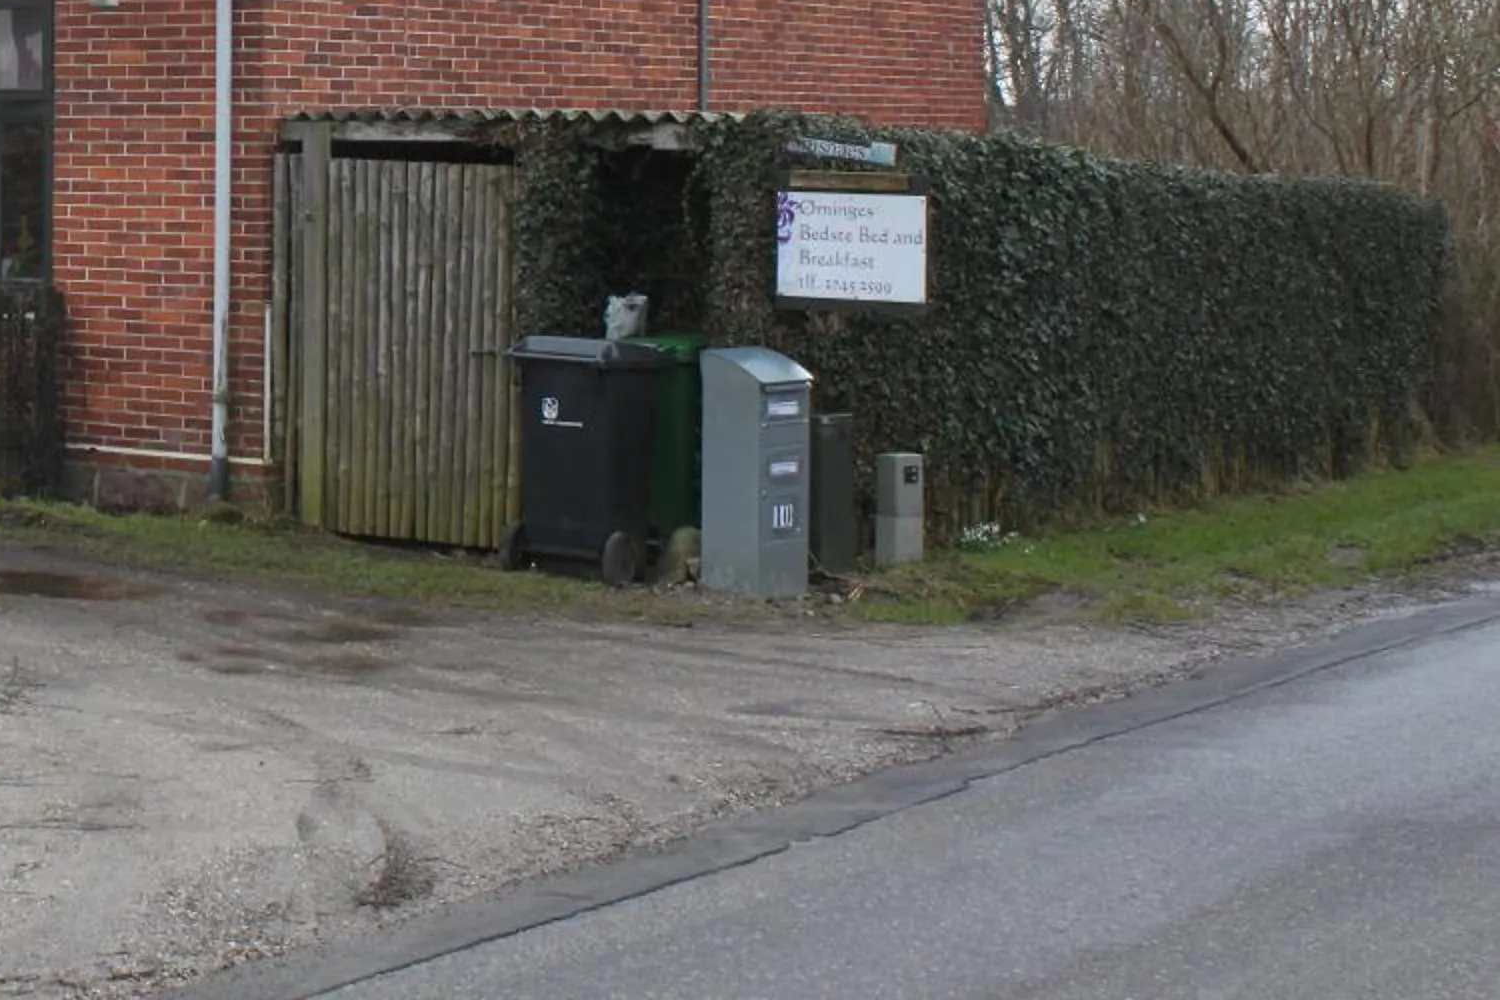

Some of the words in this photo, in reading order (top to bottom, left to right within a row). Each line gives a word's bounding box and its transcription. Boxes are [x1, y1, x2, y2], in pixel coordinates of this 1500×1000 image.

[859, 225, 889, 244] Bed
[893, 228, 923, 245] and
[799, 248, 875, 269] Breakfast
